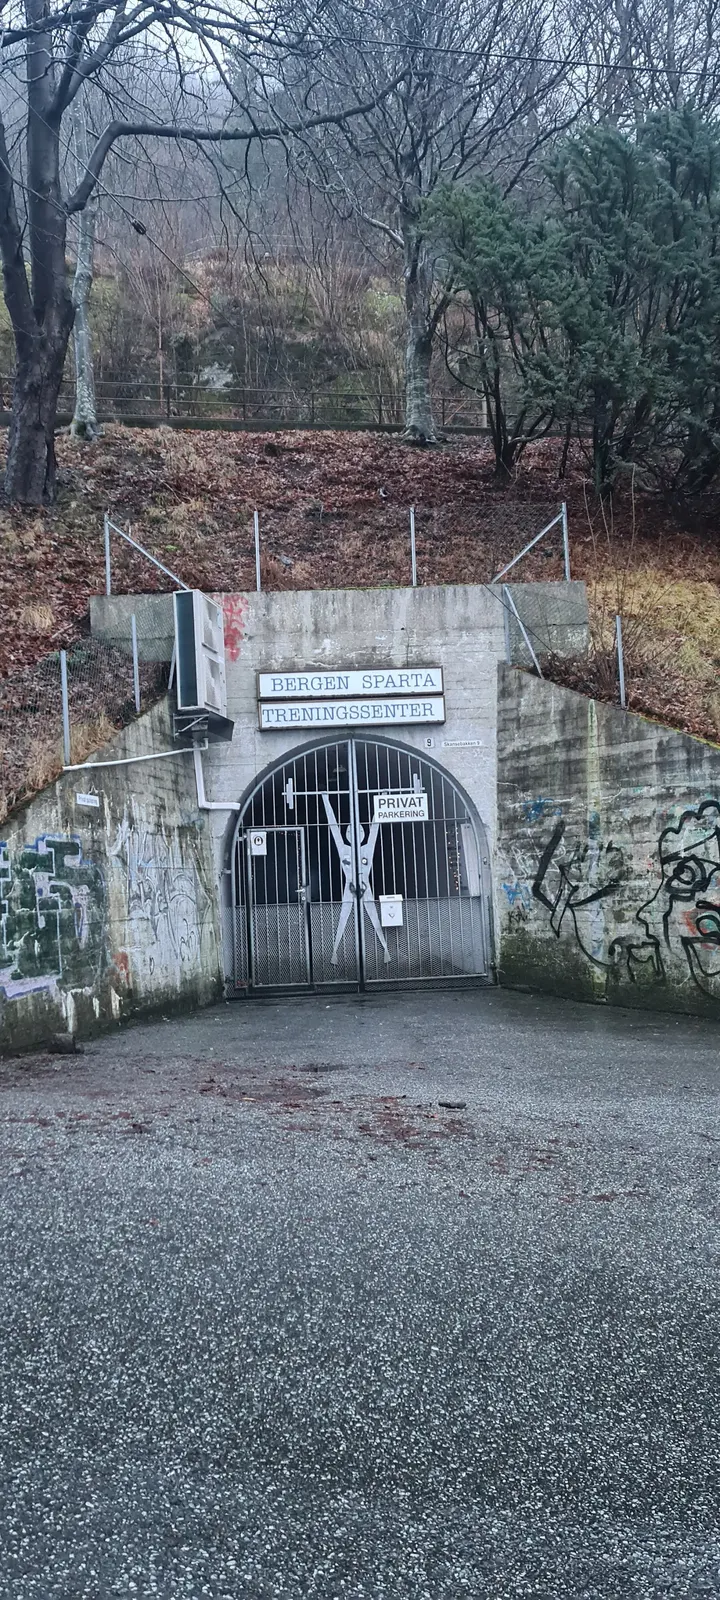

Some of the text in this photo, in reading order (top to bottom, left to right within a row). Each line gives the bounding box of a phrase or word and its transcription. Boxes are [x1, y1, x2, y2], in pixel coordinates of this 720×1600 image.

[271, 673, 437, 692] BERGEN SPARTA
[262, 703, 435, 723] TRENINGSSENTER
[426, 738, 432, 747] 9
[378, 796, 424, 809] PRIVAT
[378, 810, 425, 819] PARKERING
